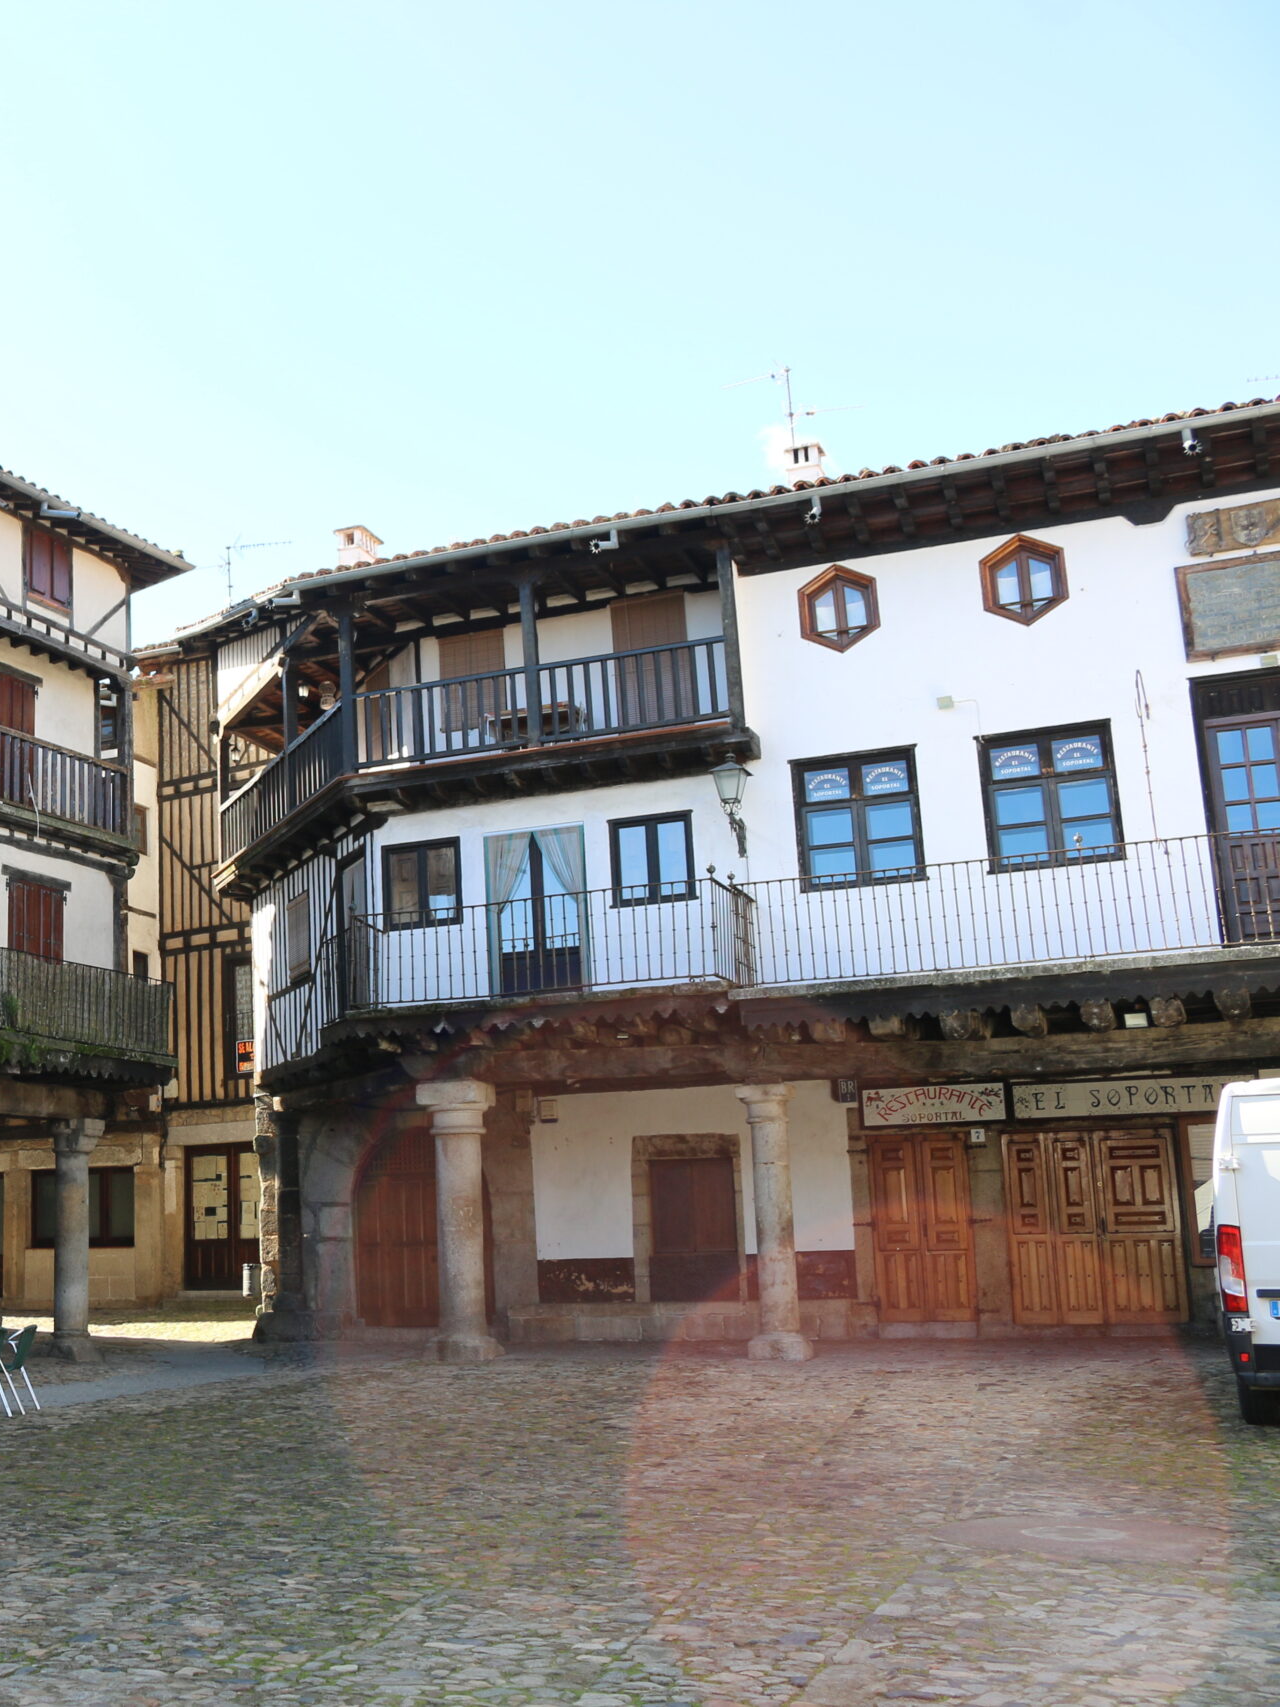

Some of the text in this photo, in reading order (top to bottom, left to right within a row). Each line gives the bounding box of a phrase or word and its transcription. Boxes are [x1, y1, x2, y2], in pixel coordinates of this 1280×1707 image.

[840, 1080, 856, 1094] BR
[1031, 1083, 1224, 1111] EL SOPORTA
[876, 1086, 993, 1122] RESTAURANTE
[901, 1111, 966, 1123] SOPORTAL
